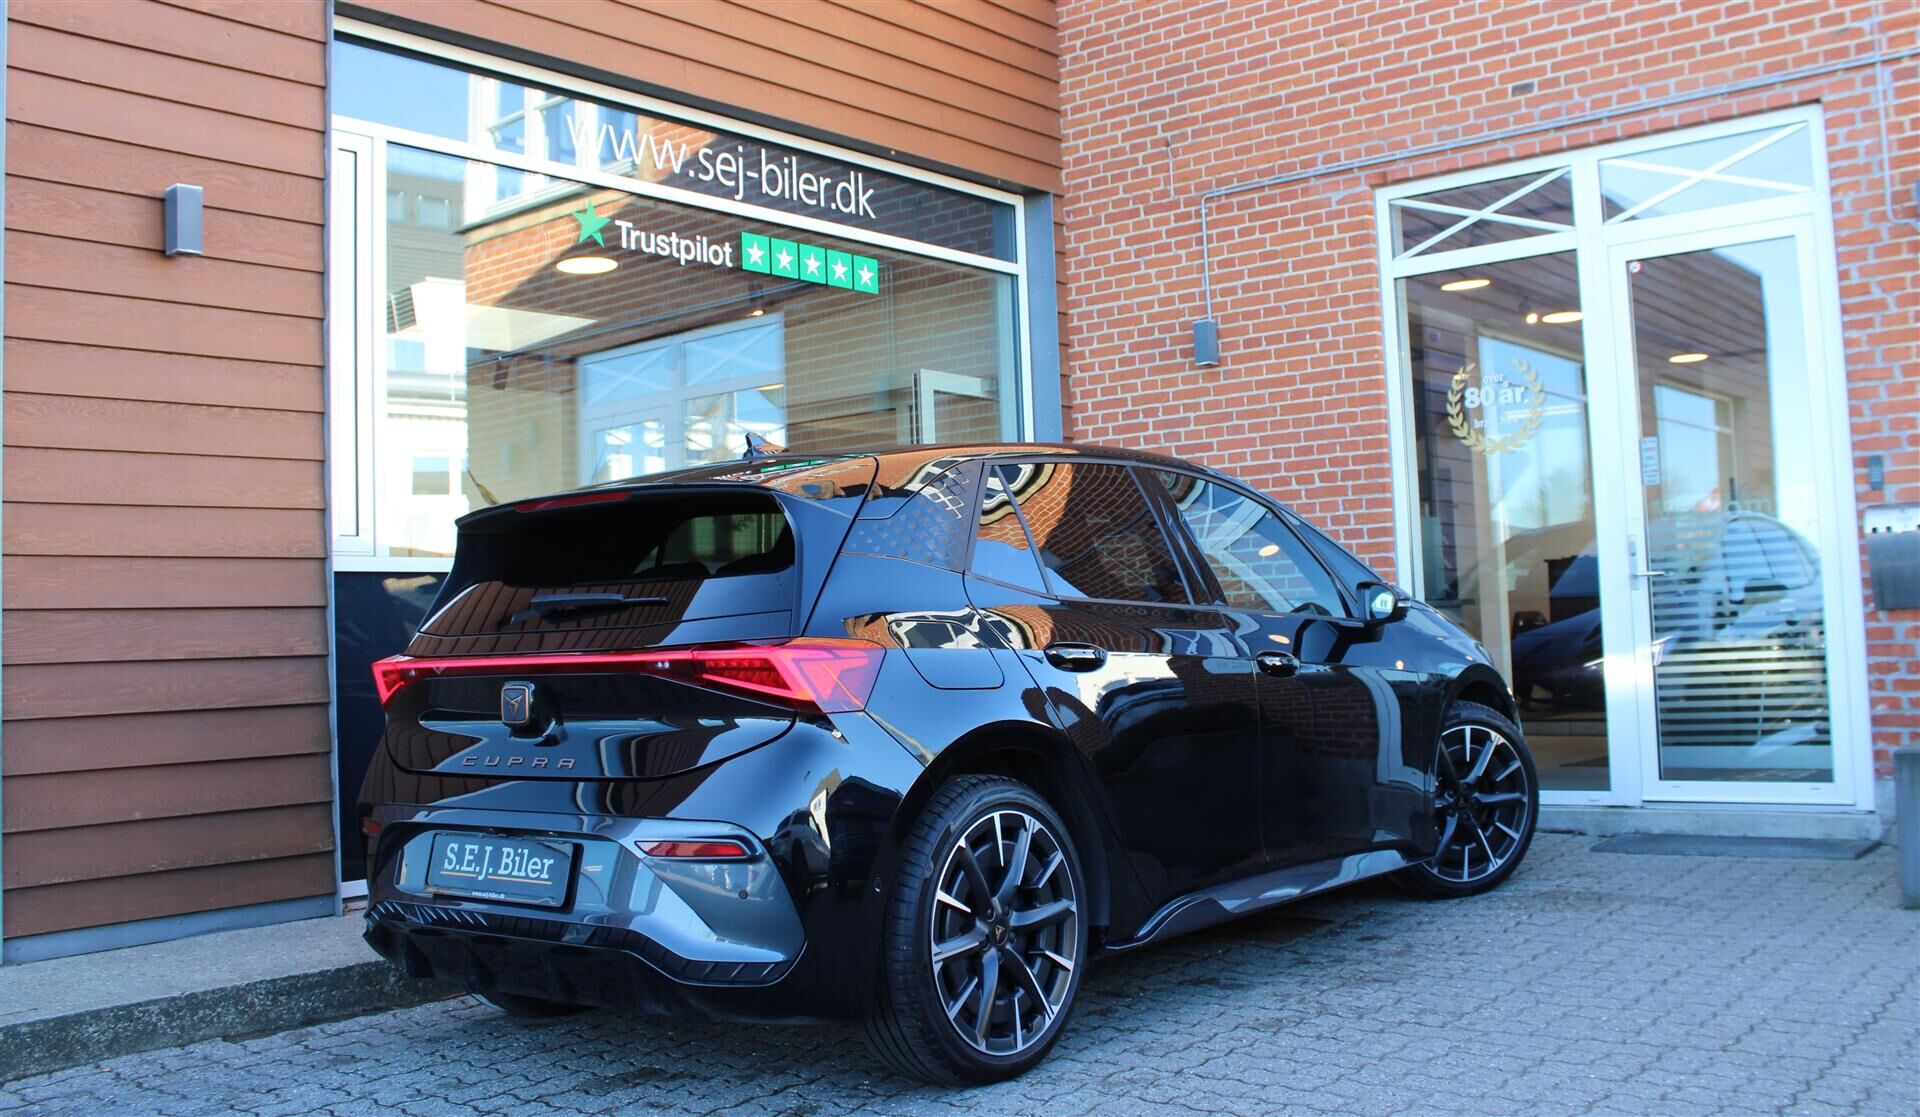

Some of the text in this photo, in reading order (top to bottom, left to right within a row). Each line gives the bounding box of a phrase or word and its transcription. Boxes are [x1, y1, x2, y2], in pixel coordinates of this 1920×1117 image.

[566, 115, 876, 219] www.sej-biler.dk
[615, 220, 733, 268] Trustpilot
[1482, 374, 1504, 384] over
[1464, 385, 1495, 409] 80
[1474, 415, 1520, 429] brchen
[462, 755, 576, 769] CUPRA
[443, 842, 554, 881] S.E.J. Biler
